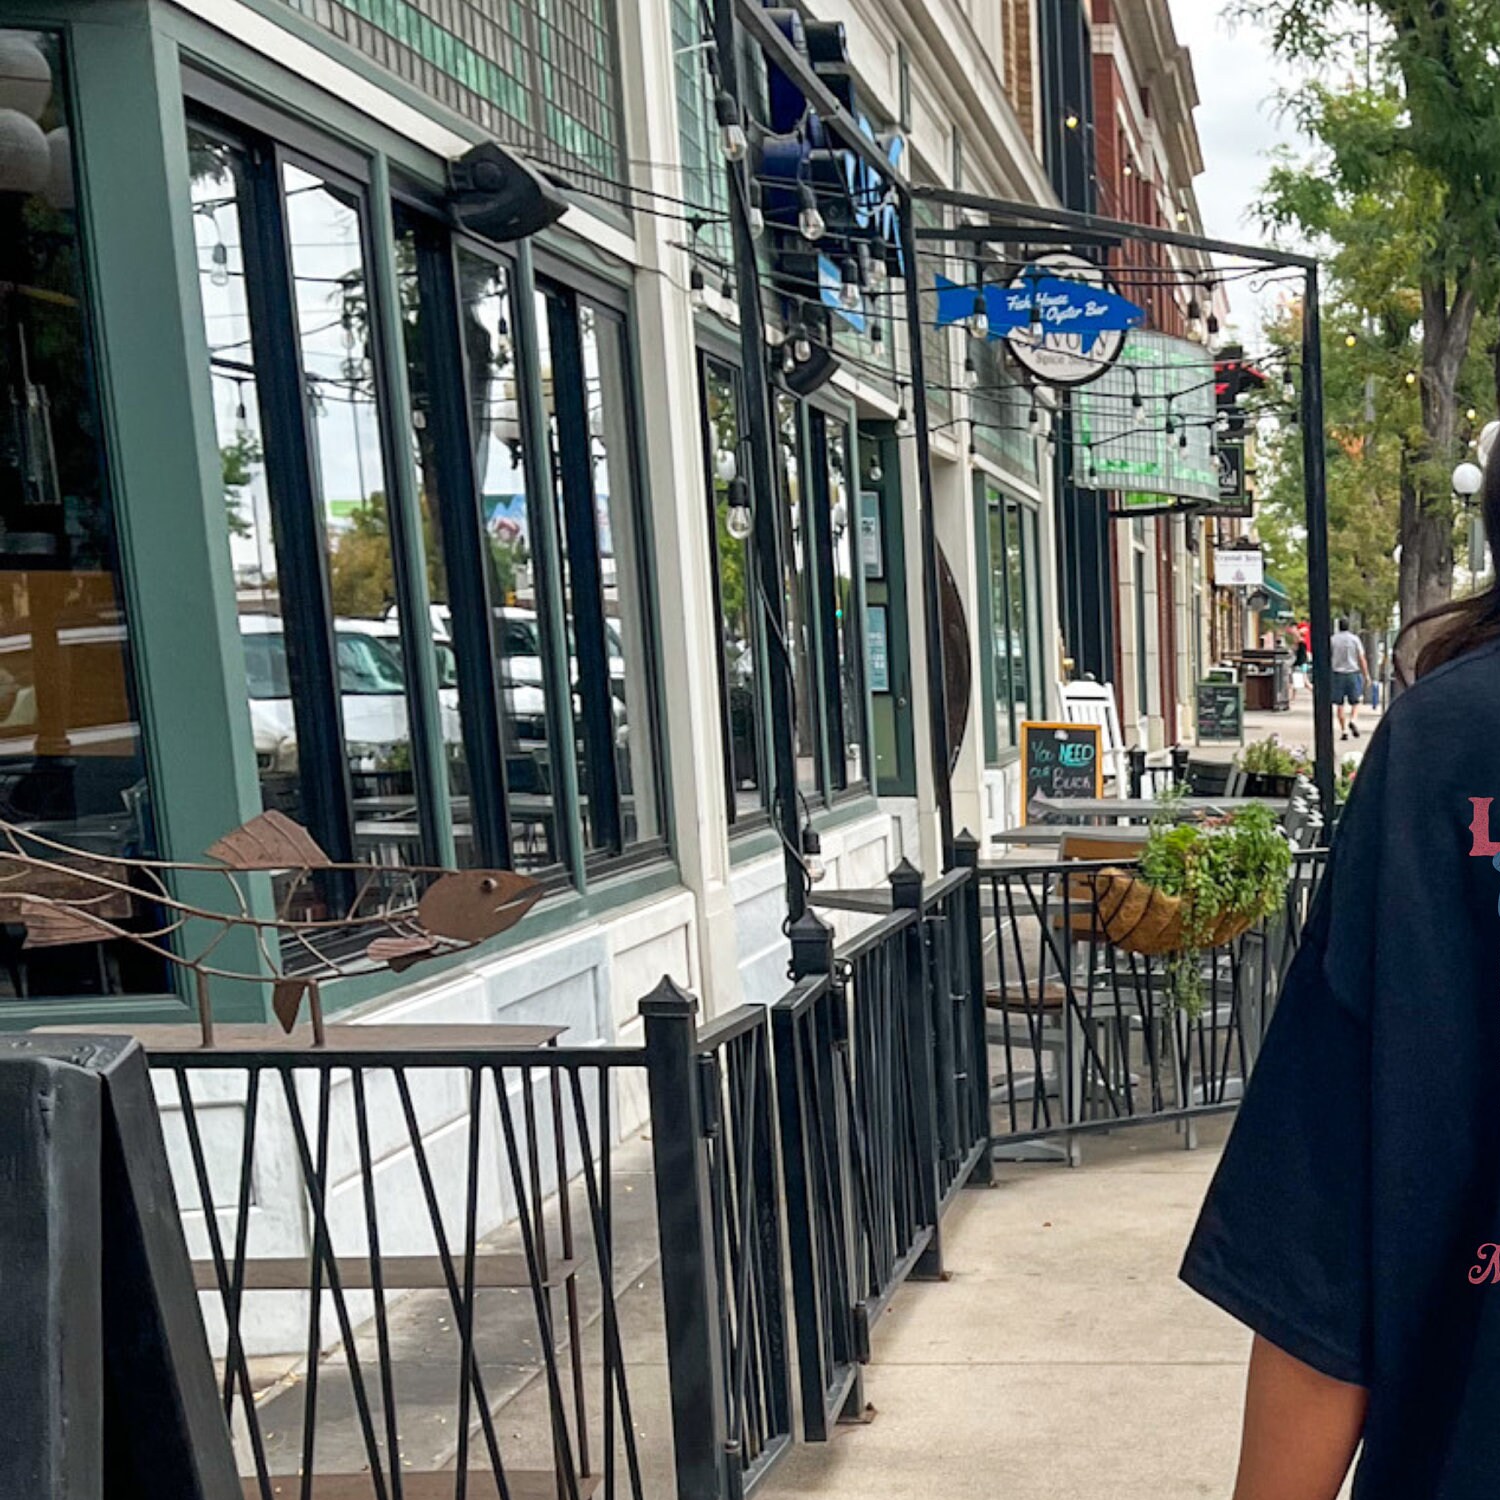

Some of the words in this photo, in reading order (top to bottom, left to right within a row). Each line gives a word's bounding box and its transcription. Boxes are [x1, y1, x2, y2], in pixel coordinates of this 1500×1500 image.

[1006, 293, 1031, 311] Fish
[1046, 305, 1083, 326] Oyster
[1085, 301, 1109, 317] Bar
[1058, 743, 1095, 763] NEED
